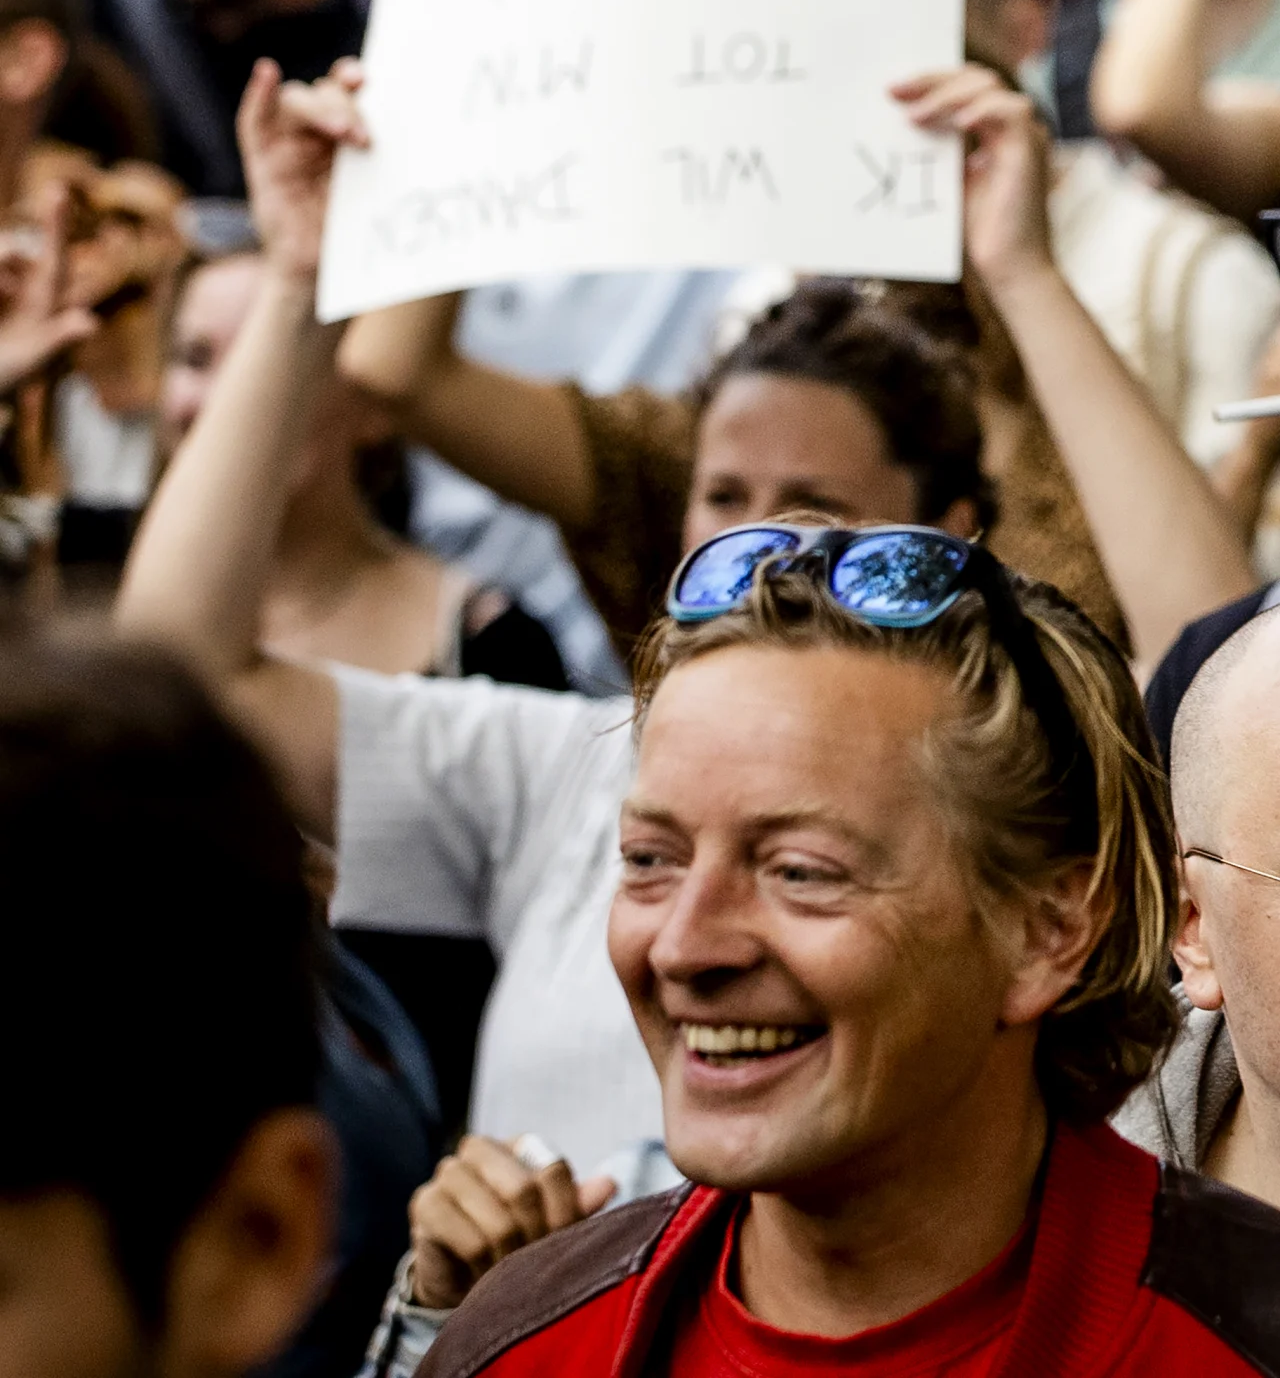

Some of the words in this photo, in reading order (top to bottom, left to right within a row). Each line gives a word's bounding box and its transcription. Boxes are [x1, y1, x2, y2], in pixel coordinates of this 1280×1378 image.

[676, 32, 808, 88] TOT
[662, 144, 782, 208] WIL
[854, 143, 940, 217] IK
